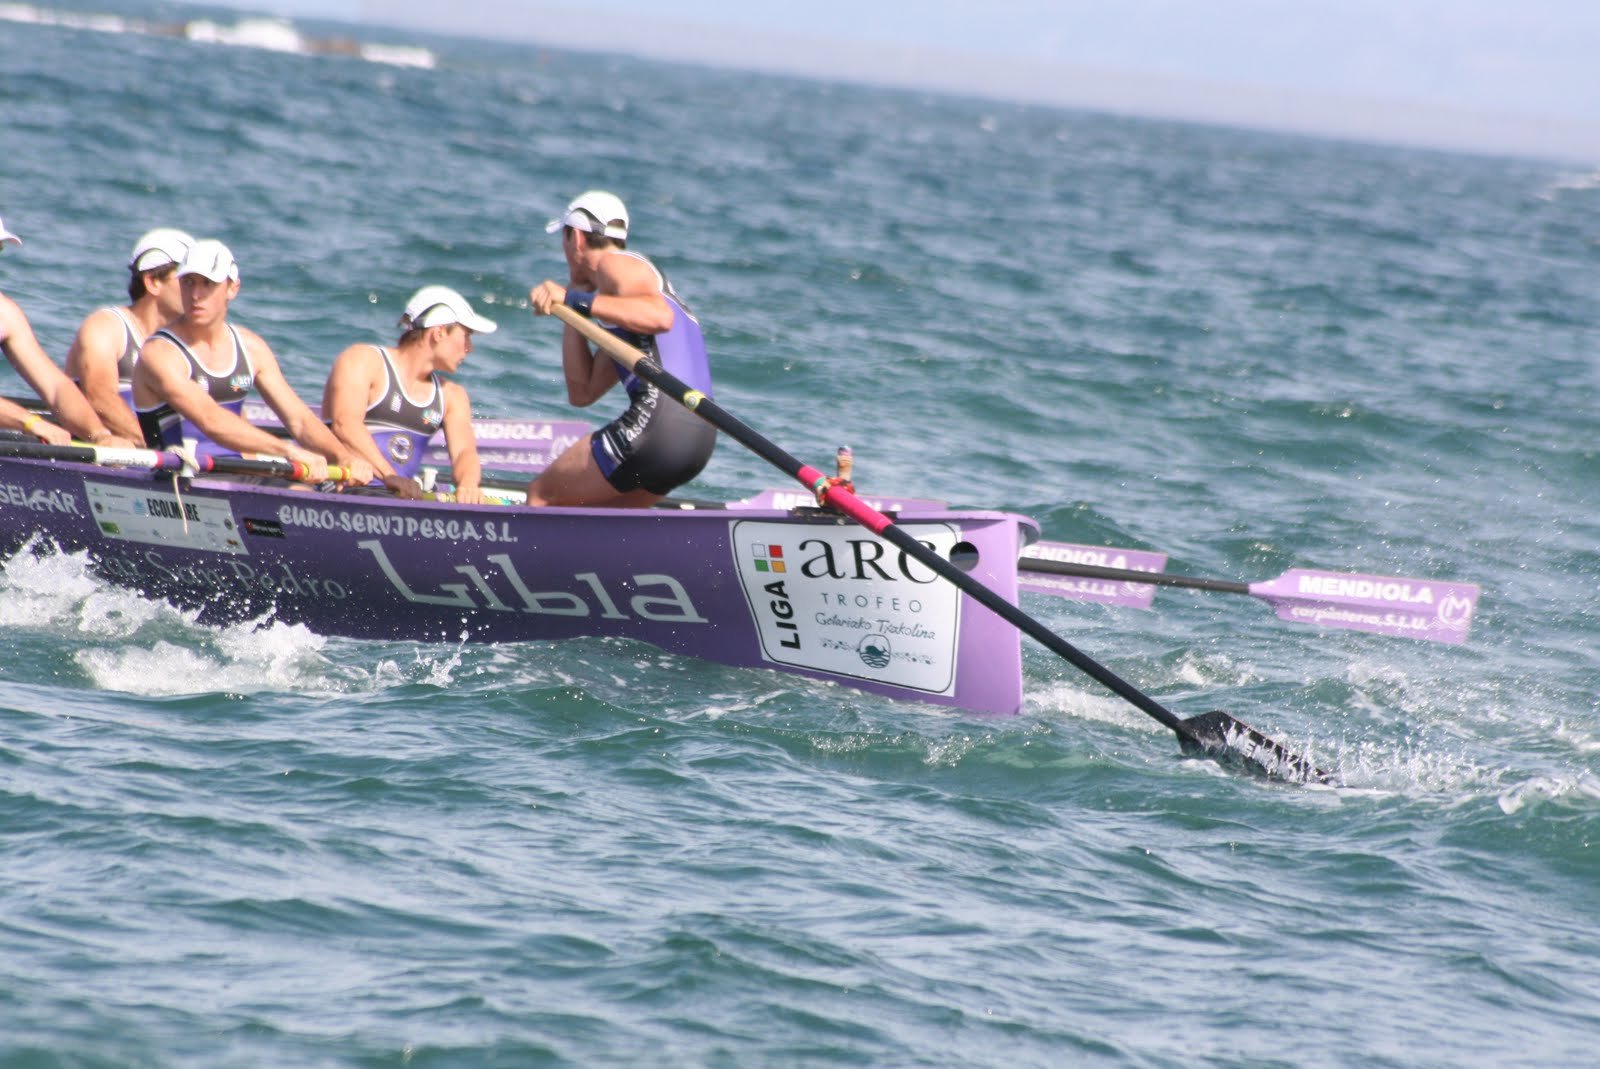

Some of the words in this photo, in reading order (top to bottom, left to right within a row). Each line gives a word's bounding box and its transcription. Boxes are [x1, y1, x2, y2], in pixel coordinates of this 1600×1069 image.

[471, 423, 554, 441] NDIOLA
[225, 559, 347, 599] Pedro
[1299, 575, 1434, 605] MENDIOLA
[763, 580, 802, 651] LIGA
[820, 592, 923, 613] TROFEO
